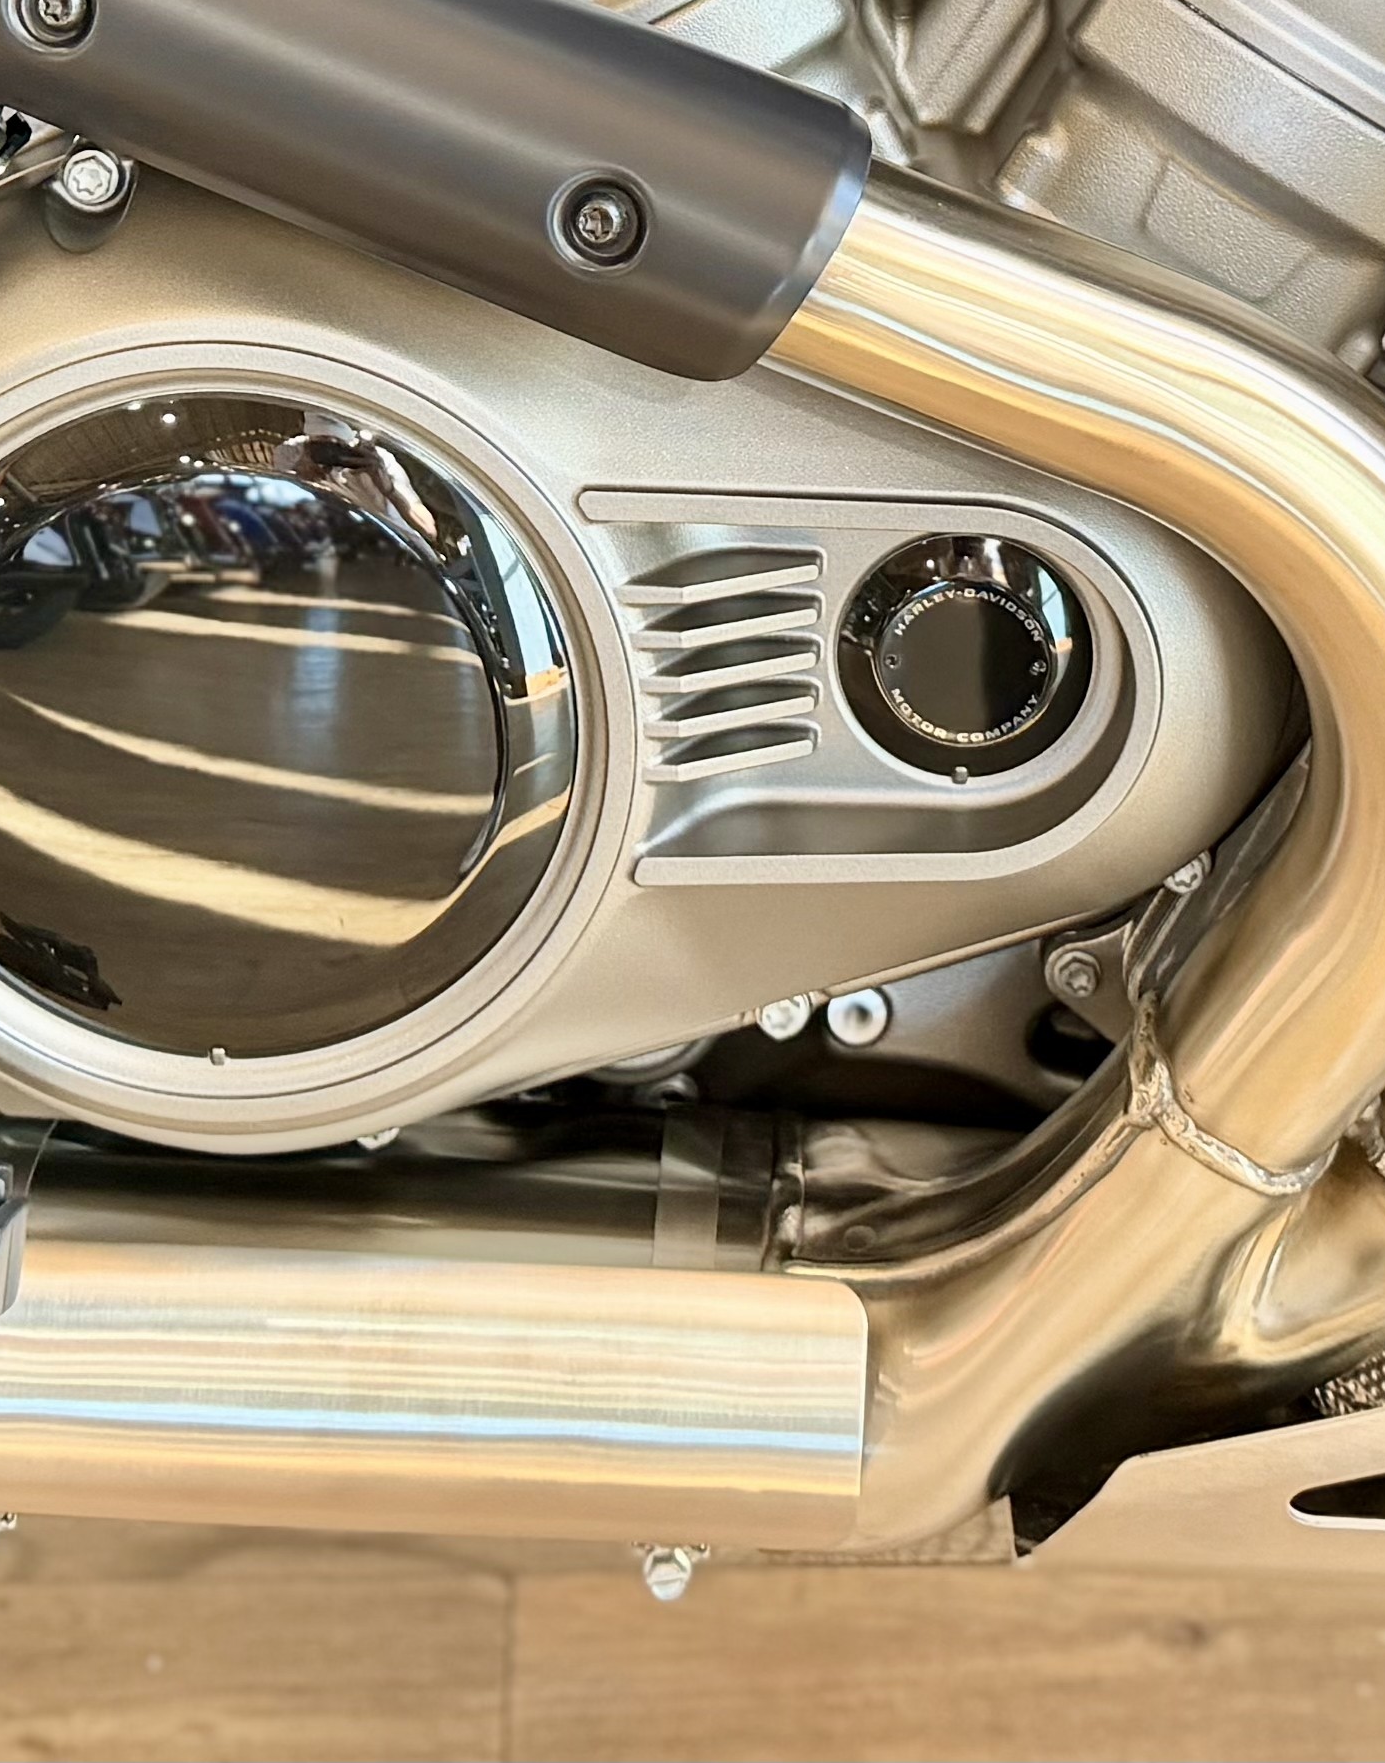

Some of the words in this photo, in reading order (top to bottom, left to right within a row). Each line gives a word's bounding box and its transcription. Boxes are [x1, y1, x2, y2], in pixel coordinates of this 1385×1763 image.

[894, 588, 1044, 642] HARLEY-DAVIDSON
[891, 688, 948, 740] MOTOR
[956, 694, 1040, 743] COMPANY
